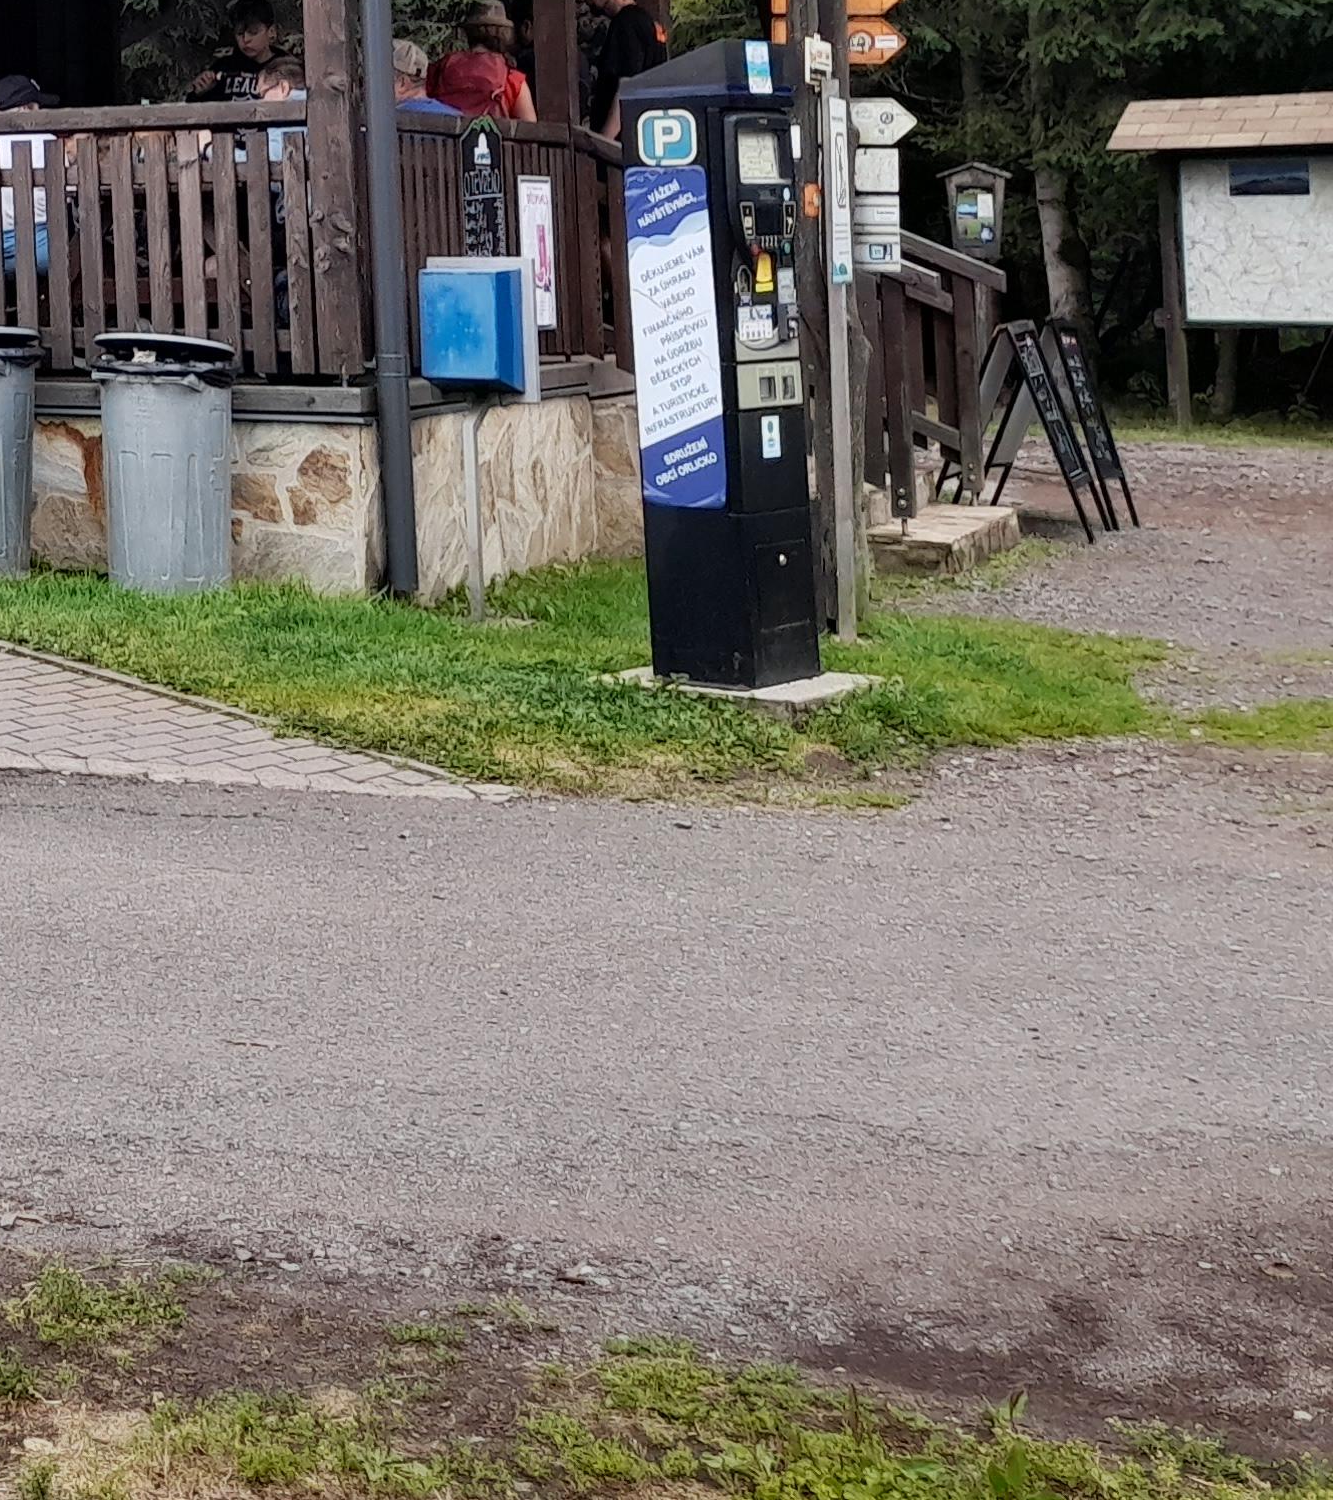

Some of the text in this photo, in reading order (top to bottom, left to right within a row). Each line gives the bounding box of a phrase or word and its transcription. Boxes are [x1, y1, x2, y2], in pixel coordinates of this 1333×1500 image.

[654, 119, 682, 157] P
[647, 178, 680, 204] VÁŽENÍ
[640, 244, 705, 283] DĚKUJEME VÁM
[647, 266, 696, 297] ZA ÚHRADU
[660, 286, 695, 309] VAŠEHO
[642, 306, 693, 337] FINANČNÍHO
[660, 318, 708, 346] PŘÍSPĚVKU
[654, 337, 703, 366] NA ÚDRŽBU
[650, 355, 702, 385] BĚŽECKÝCH
[669, 374, 692, 391] STOP
[652, 382, 709, 416] A TURISTICKÉ
[644, 394, 718, 436] INFRASTRUKTURY
[663, 436, 708, 465] SDRUŽENÍ
[655, 451, 718, 486] OBCÍ ORLICKO
